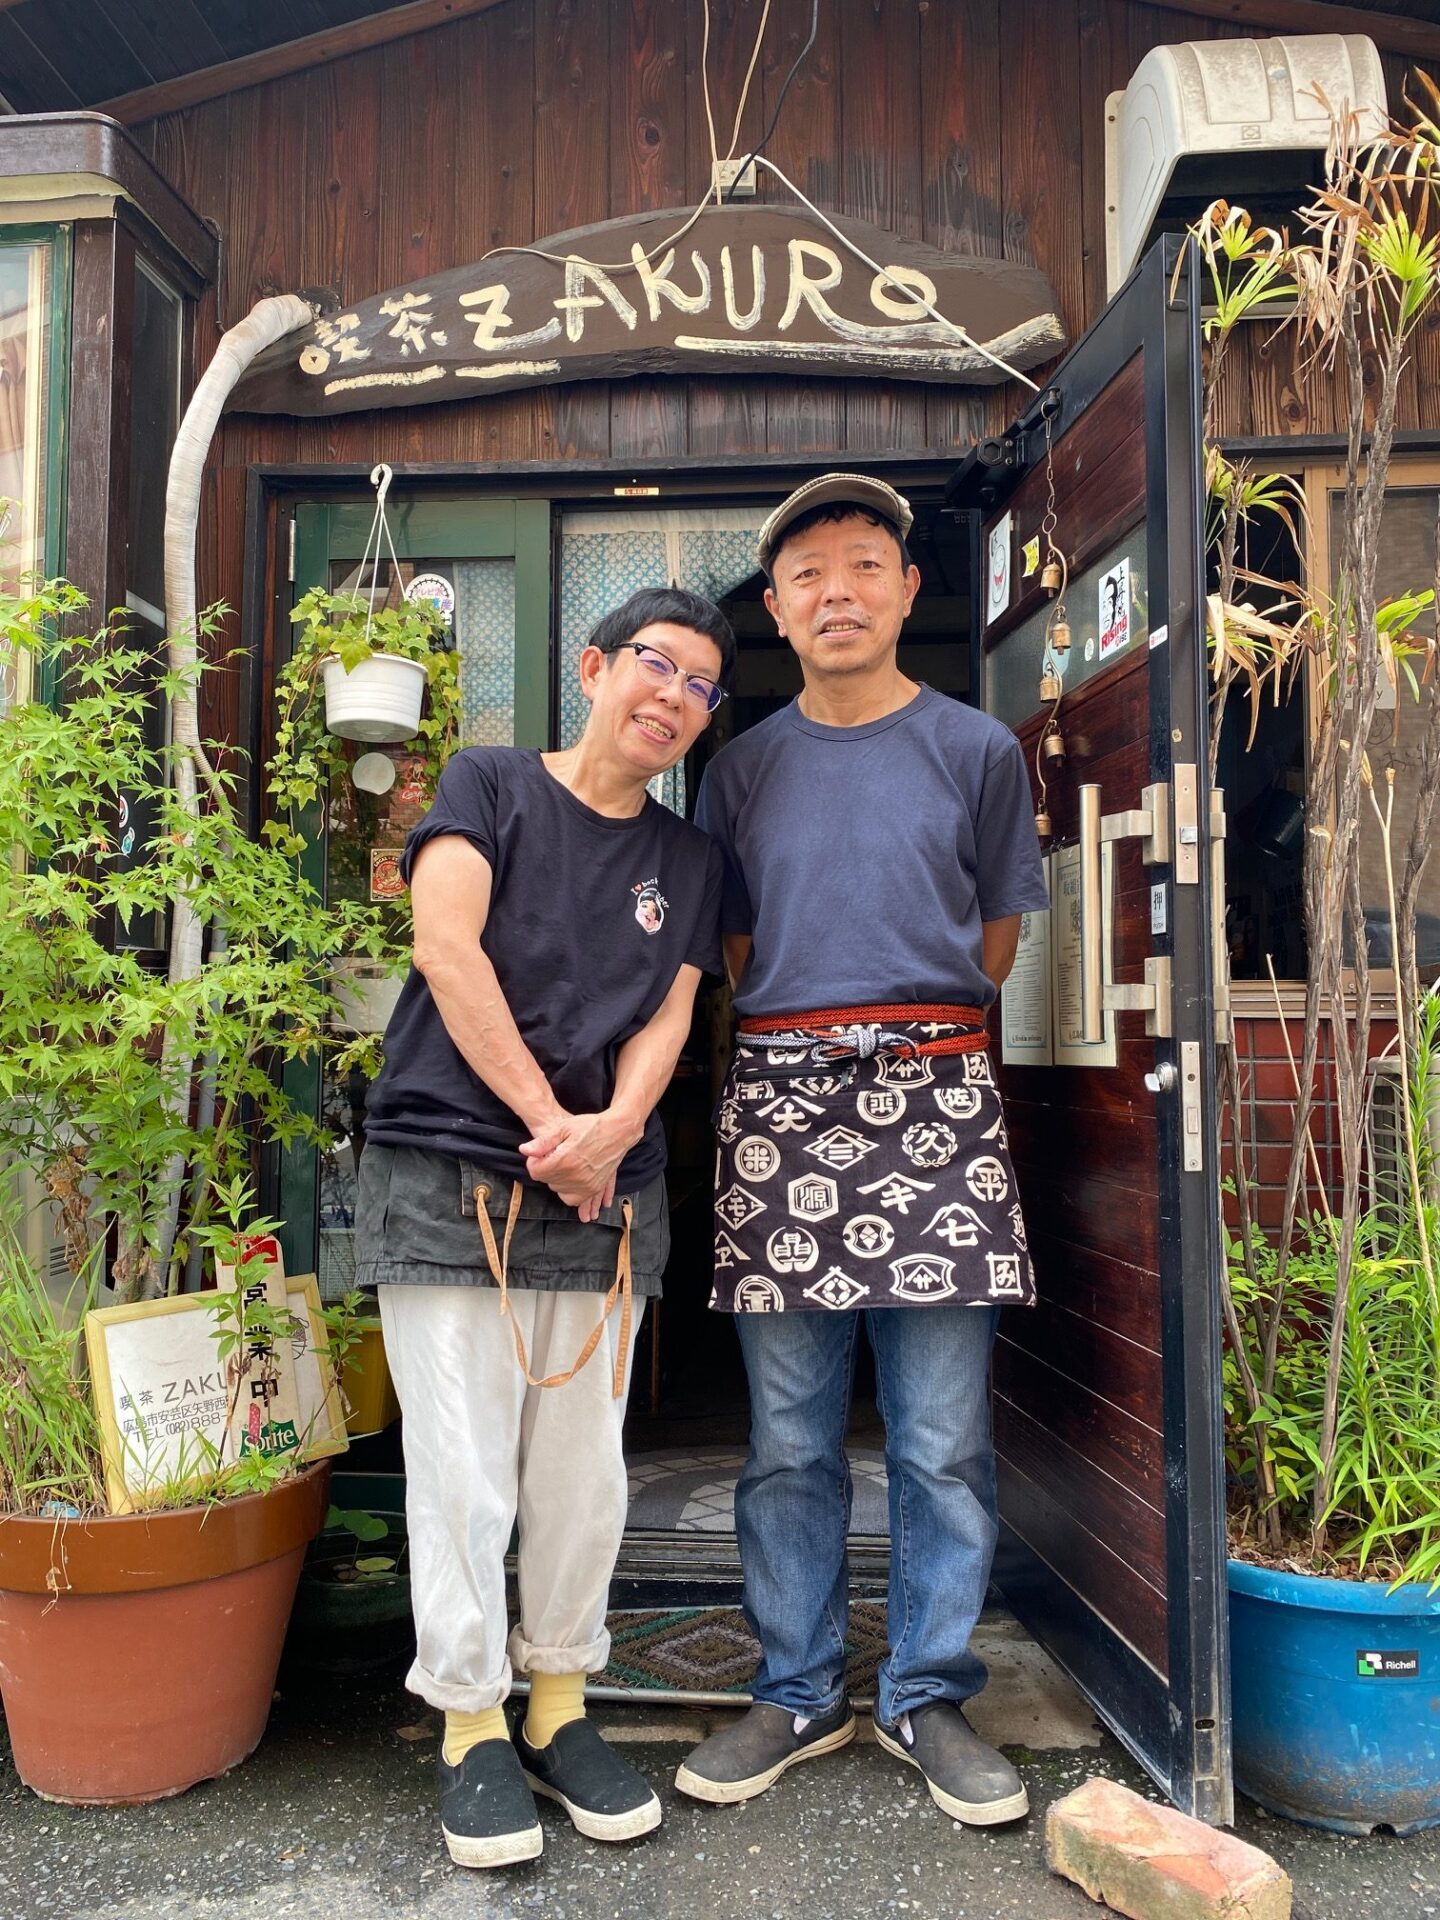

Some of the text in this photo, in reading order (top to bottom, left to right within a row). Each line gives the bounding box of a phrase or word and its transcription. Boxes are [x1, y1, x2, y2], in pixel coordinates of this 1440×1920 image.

[299, 238, 966, 375] 喫茶 ZAKURO
[1101, 614, 1128, 652] Rising
[1153, 890, 1163, 910] 押
[122, 1393, 230, 1434] 広島市安芸区矢野西
[135, 1426, 164, 1443] TEL
[1385, 1659, 1417, 1670] Richell
